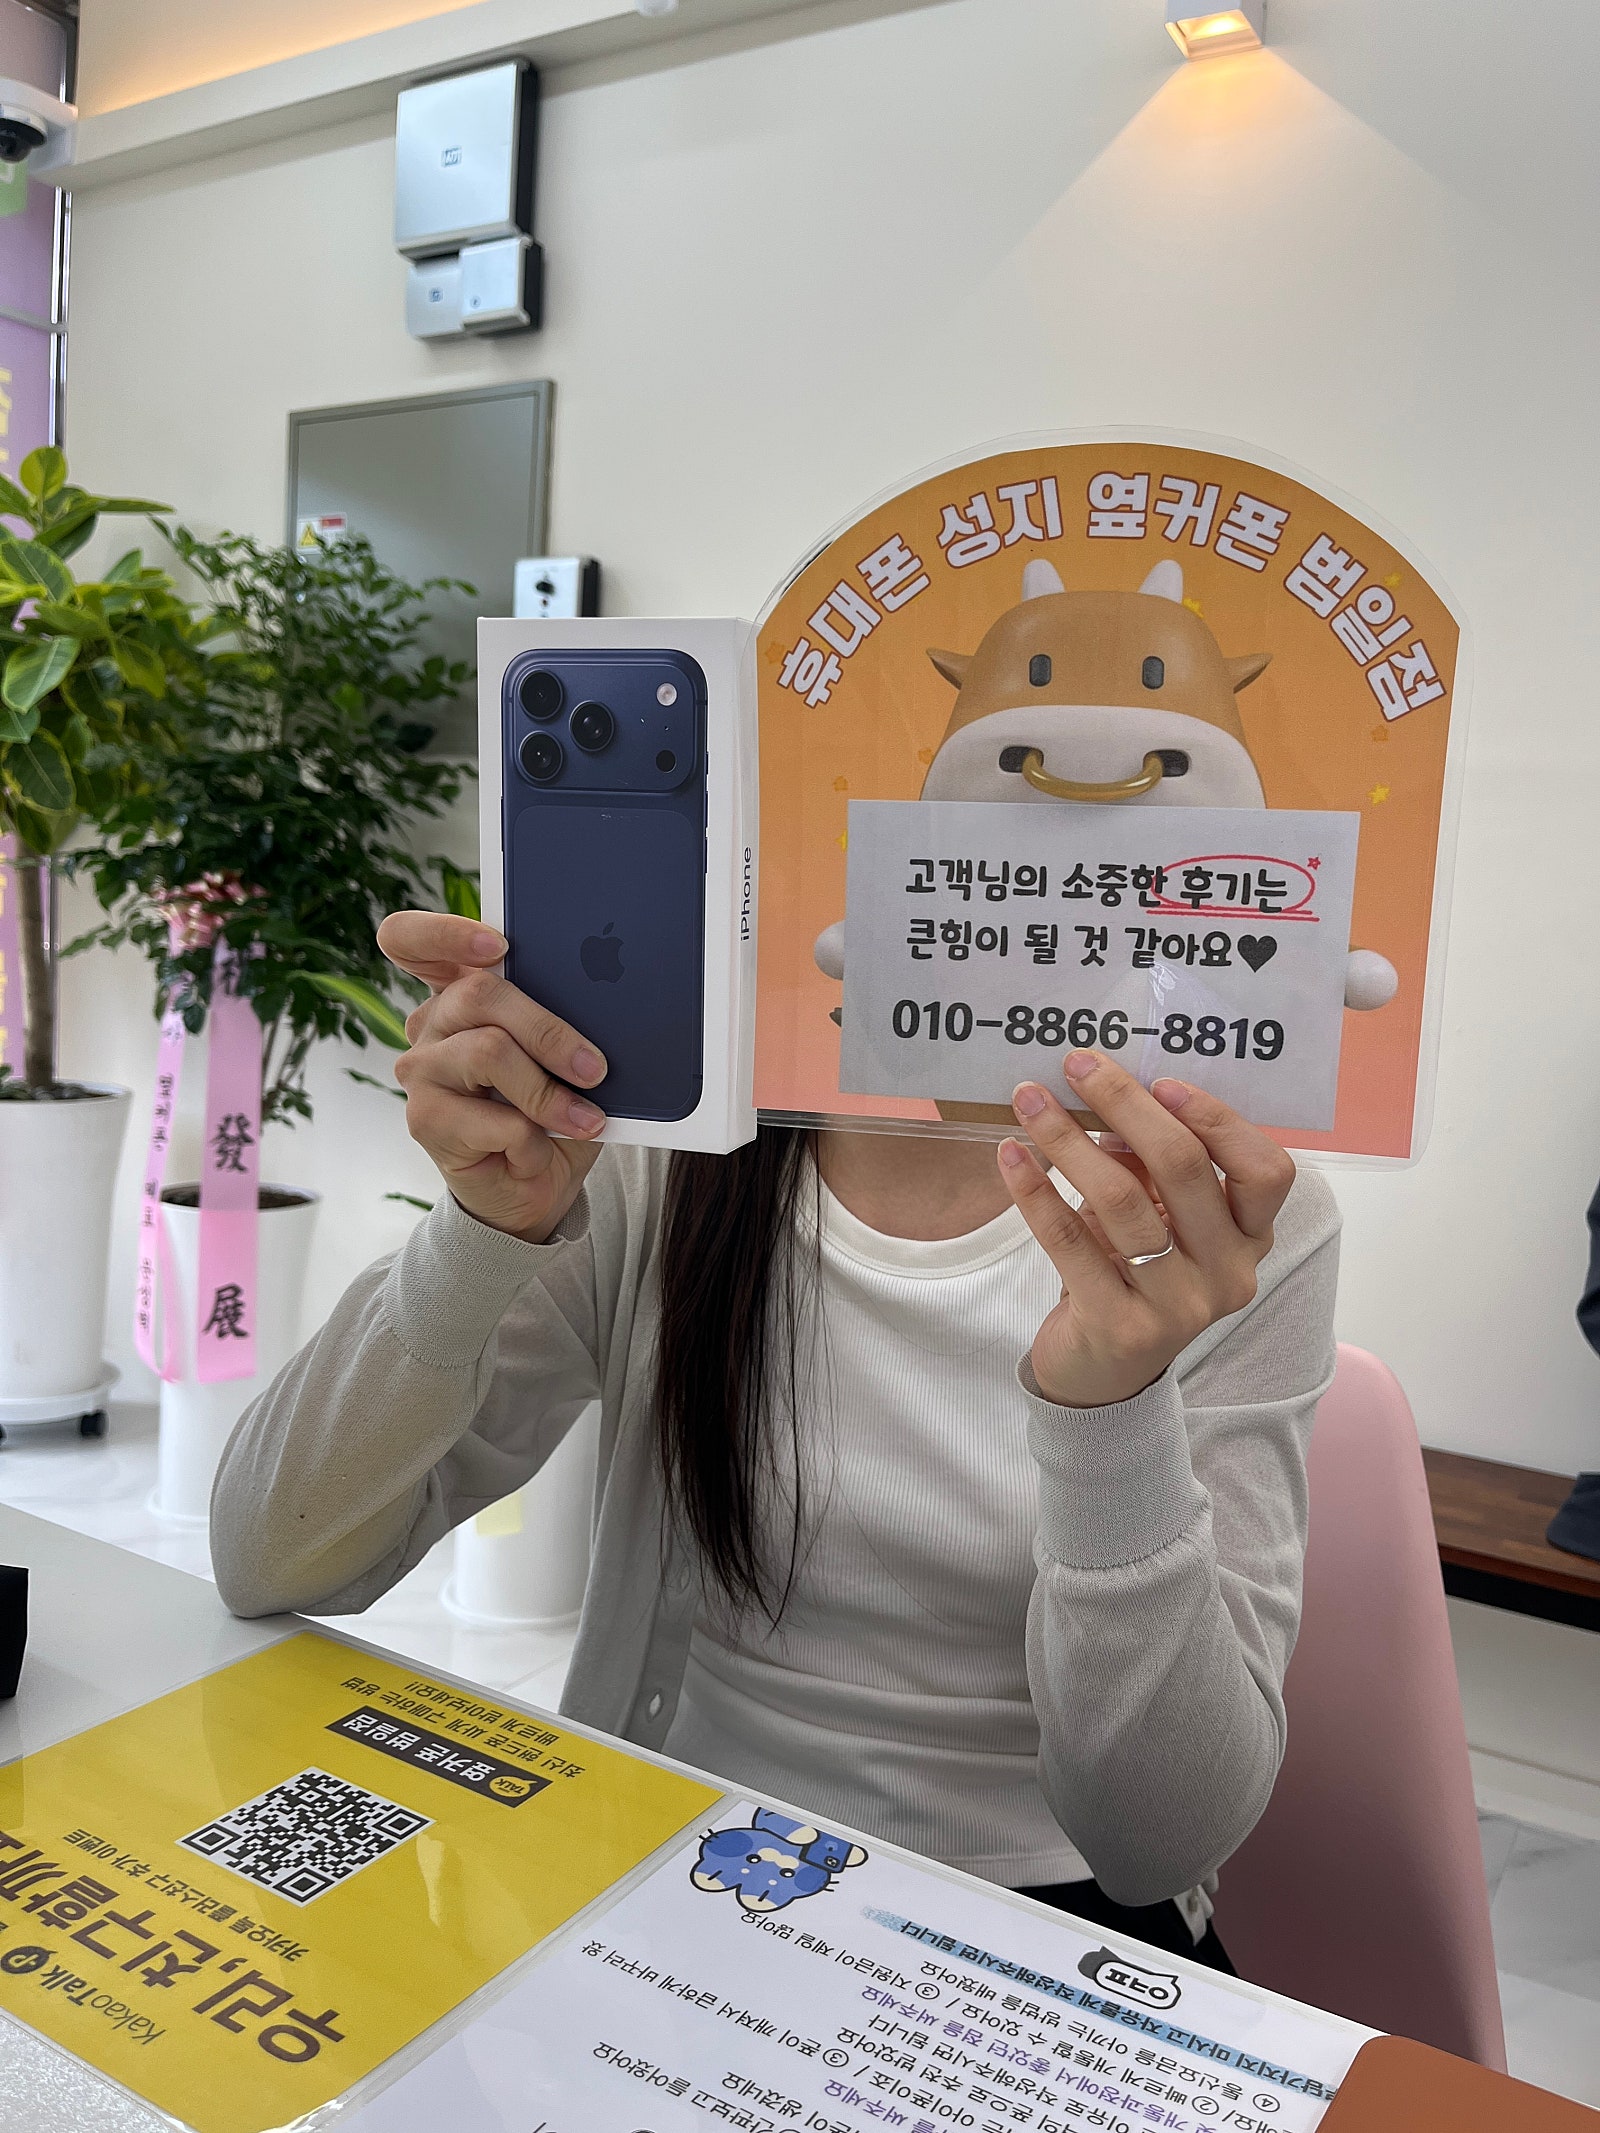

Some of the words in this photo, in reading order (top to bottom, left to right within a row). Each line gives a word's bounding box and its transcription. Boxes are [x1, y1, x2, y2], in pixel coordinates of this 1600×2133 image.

[777, 533, 931, 709] 휴대폰
[936, 475, 1065, 568] 성지
[1086, 470, 1291, 573] 옆커폰
[1283, 532, 1448, 722] 범일점
[740, 846, 752, 941] iPhone
[905, 858, 1048, 901] 고객님의
[1061, 863, 1169, 908] 소중한
[1180, 866, 1288, 913] 후기는
[906, 918, 1008, 961] 큰힘이
[1023, 924, 1059, 966] 될
[1074, 925, 1107, 967] 것
[892, 999, 1285, 1061] 010-8866-8819
[339, 1676, 381, 1697] 방법
[403, 1681, 504, 1724] 받아보세요!!
[378, 1690, 447, 1724] 구매하는
[342, 1713, 422, 1751] 범일점
[444, 1718, 489, 1739] 싸게
[483, 1733, 545, 1762] 핸드폰
[499, 1717, 561, 1747] 빠르게
[414, 1743, 496, 1782] 옆커폰
[540, 1756, 586, 1778] 최신
[497, 1778, 525, 1794] TALK
[62, 1828, 118, 1859] 이벤트
[110, 1853, 151, 1878] 추가
[144, 1873, 238, 1923] 플러스친구
[228, 1915, 310, 1963] 카카오톡
[740, 1911, 795, 1940] 많아요
[793, 1932, 835, 1957] 제일
[899, 1920, 958, 1953] 됩니다
[581, 1939, 607, 1957] 왔
[601, 1949, 660, 1983] 바꾸러
[834, 1949, 913, 1991] 지원금이
[920, 1960, 998, 2001] 배웠어요
[957, 1944, 1078, 2005] 작성해주시면
[39, 1964, 167, 2046] KakaoTalk
[657, 1975, 719, 2010] 급하게
[861, 1985, 940, 2027] 써주세요
[1001, 1993, 1062, 2029] 방법을
[716, 2001, 778, 2037] 깨져서
[867, 2014, 930, 2050] 됩니다
[942, 2019, 984, 2048] 점을
[961, 2002, 1024, 2037] 있어요
[1077, 1992, 1165, 2037] 자유롭게
[777, 2029, 822, 2058] 폰이
[836, 2026, 918, 2073] 받았어요
[1027, 2032, 1048, 2046] 수
[1067, 2020, 1129, 2055] 아끼는
[1165, 2027, 1233, 2062] 마시고
[592, 2041, 692, 2098] 들어왔어요
[931, 2041, 1059, 2107] 작성해주시면
[986, 2038, 1051, 2076] 좋았던
[1050, 2040, 1117, 2076] 개통할
[1134, 2047, 1244, 2101] 통신요금을
[721, 2071, 803, 2119] 생겼네요
[918, 2063, 964, 2092] 추천
[1119, 2067, 1188, 2106] 빠르게
[690, 2089, 776, 2132] 간판보고
[823, 2079, 909, 2127] 써주세요
[868, 2070, 975, 2127] 아이폰이죠
[967, 2084, 1034, 2124] 폰으로
[1054, 2067, 1189, 2132] 개통과정에서
[1063, 2098, 1129, 2133] 이유로
